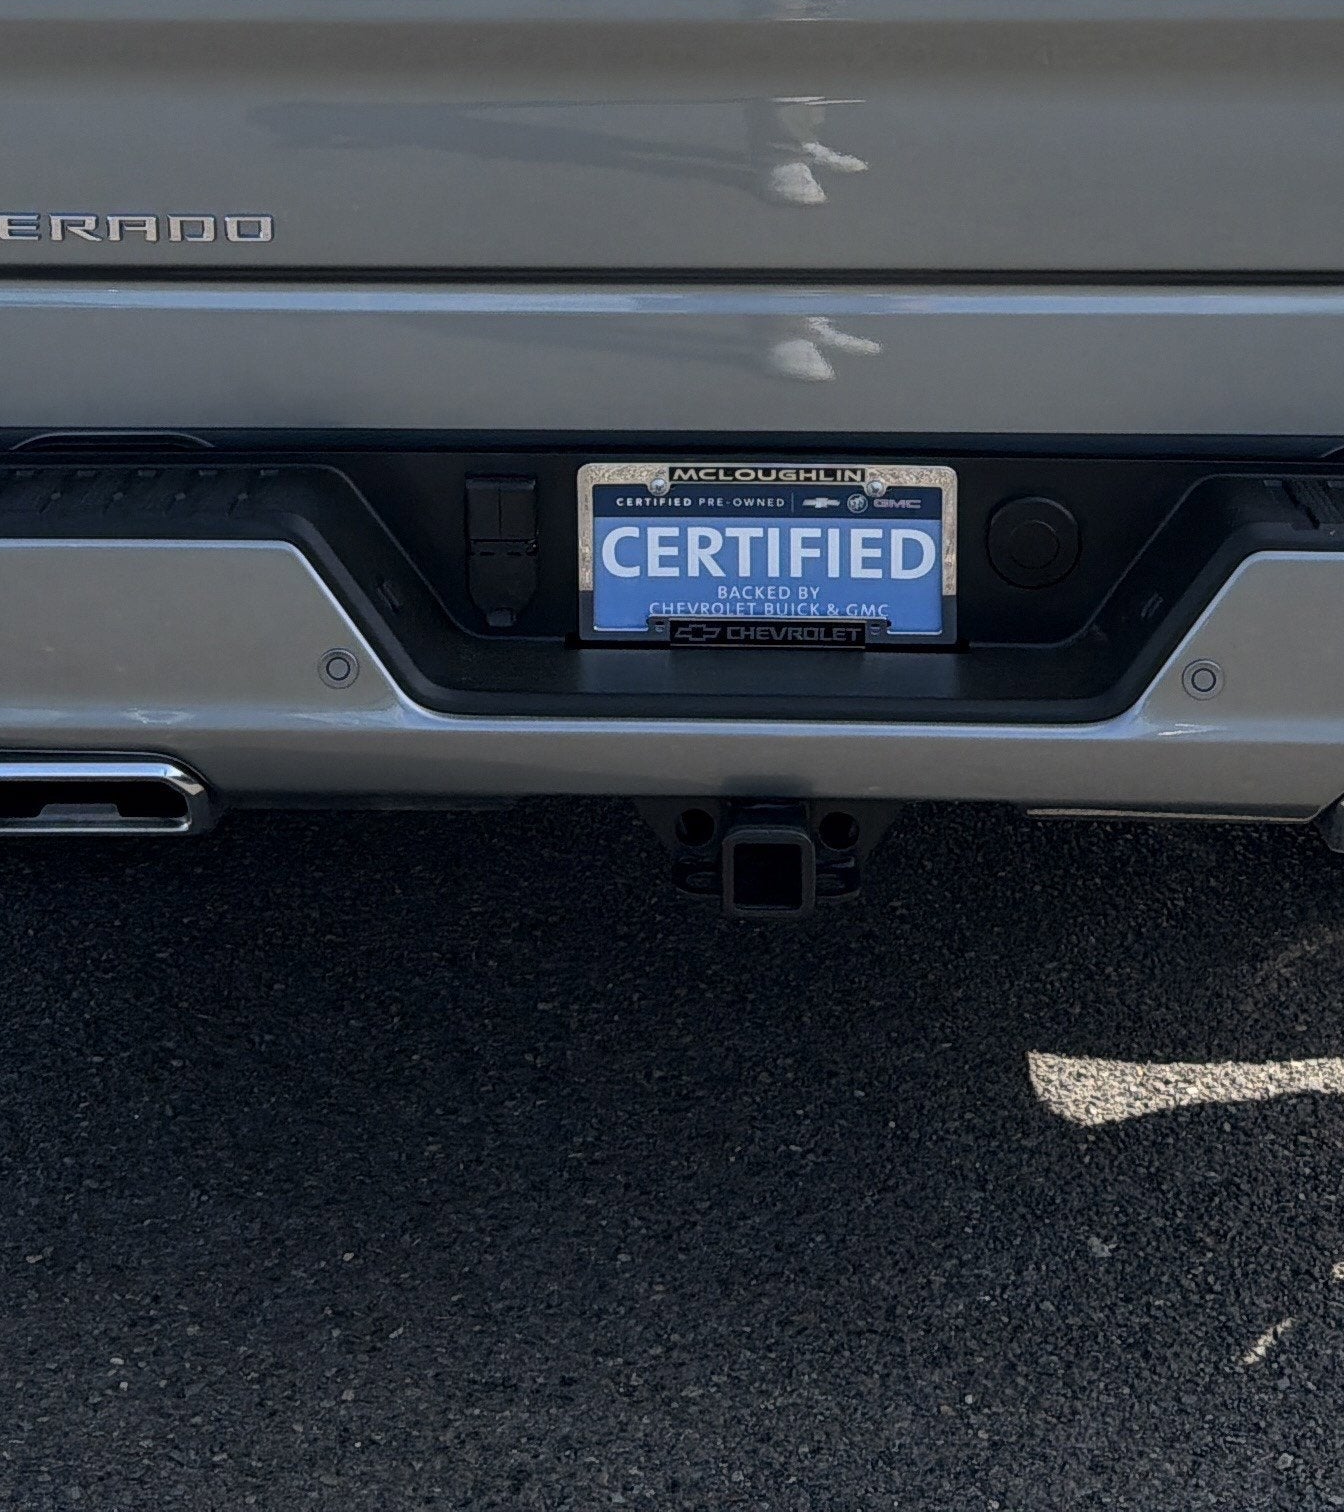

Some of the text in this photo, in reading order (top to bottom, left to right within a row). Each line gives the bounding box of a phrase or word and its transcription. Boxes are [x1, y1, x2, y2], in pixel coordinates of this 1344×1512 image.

[673, 468, 863, 482] MCLOUGHLIN
[616, 497, 921, 509] CERTIFIED PRE-OWNED GMC
[602, 526, 936, 579] CERTIFIED
[718, 586, 820, 600] BACKED BY
[650, 602, 889, 617] CHEVROLET BUICK & GMC
[726, 626, 862, 641] CHEVROLET
